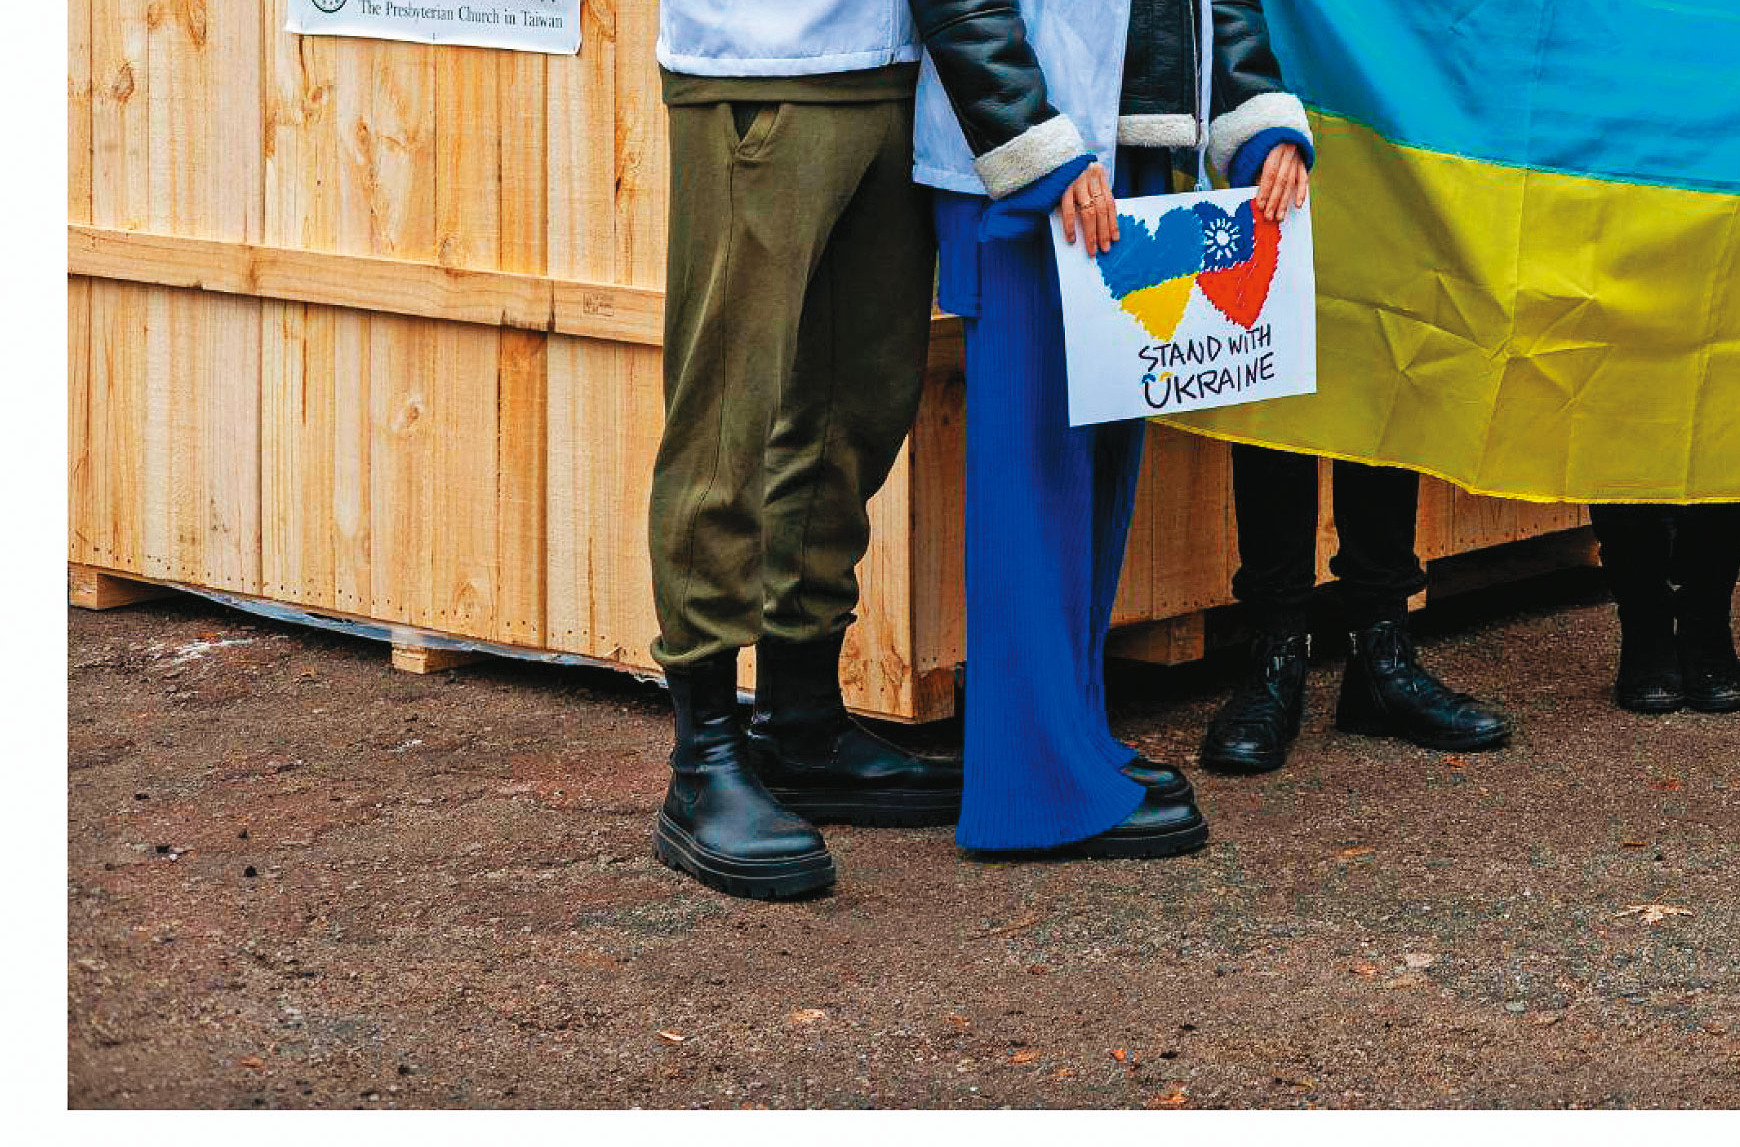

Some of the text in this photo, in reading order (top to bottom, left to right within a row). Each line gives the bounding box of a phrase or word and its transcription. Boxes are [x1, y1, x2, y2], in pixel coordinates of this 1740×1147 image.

[385, 2, 454, 21] Presbyterian
[458, 5, 500, 25] Church
[504, 8, 516, 26] in
[522, 9, 563, 29] Taiwan
[1138, 323, 1272, 372] STAND WITH
[1142, 351, 1275, 409] UKRAINE
